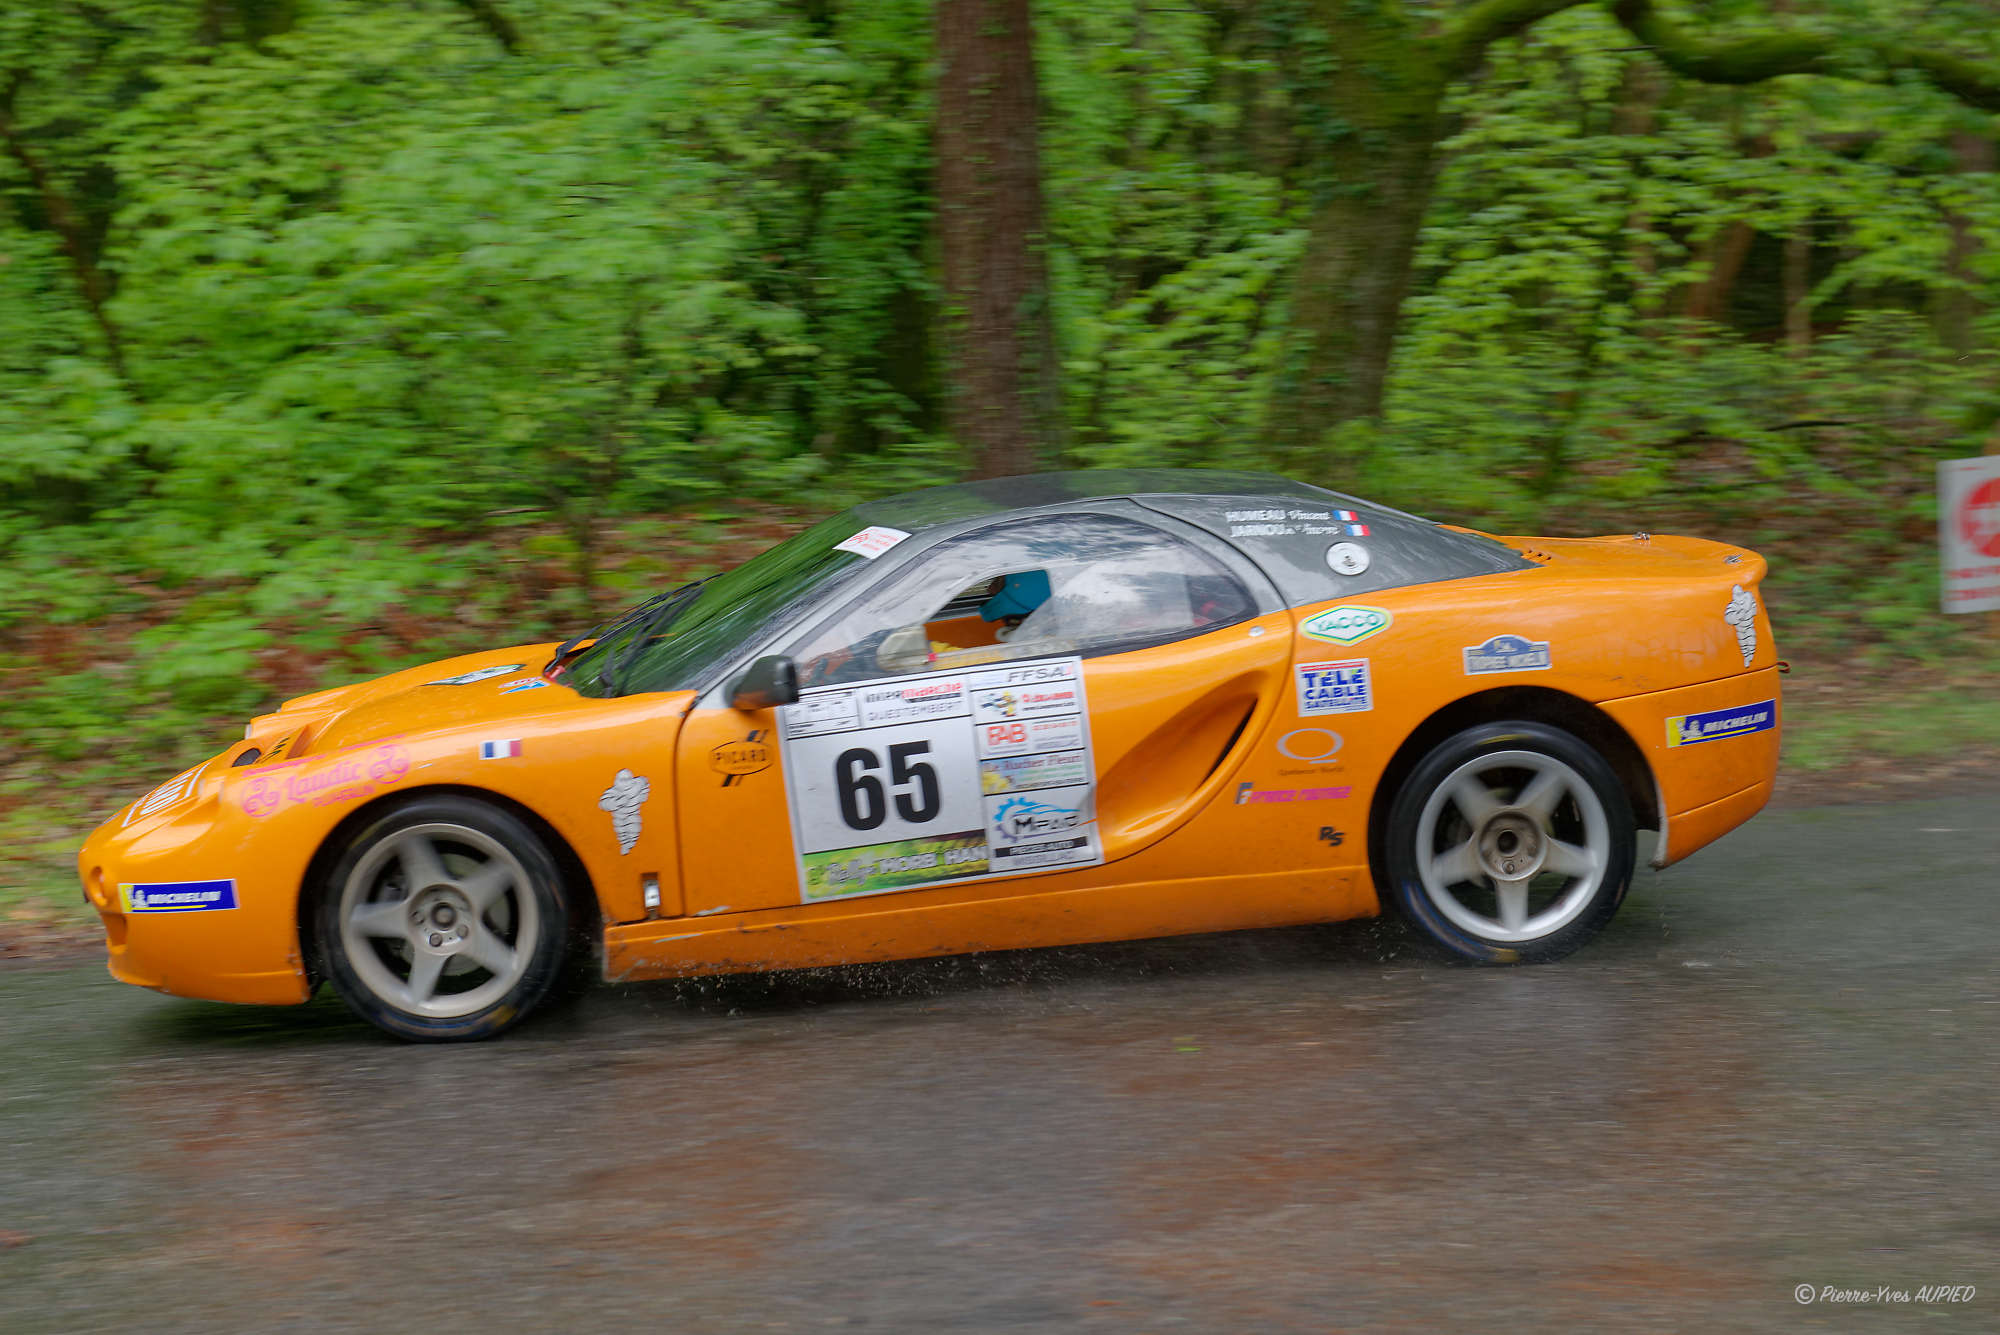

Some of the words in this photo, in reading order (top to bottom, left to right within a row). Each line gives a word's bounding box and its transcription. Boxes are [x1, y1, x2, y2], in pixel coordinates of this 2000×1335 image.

[1312, 613, 1380, 632] YACCO
[1007, 666, 1065, 682] FFSA
[1304, 685, 1367, 701] CABLE
[1703, 711, 1768, 733] MICHELIN
[836, 740, 940, 831] 65
[1319, 826, 1345, 847] RS
[147, 890, 221, 904] MICHELIN
